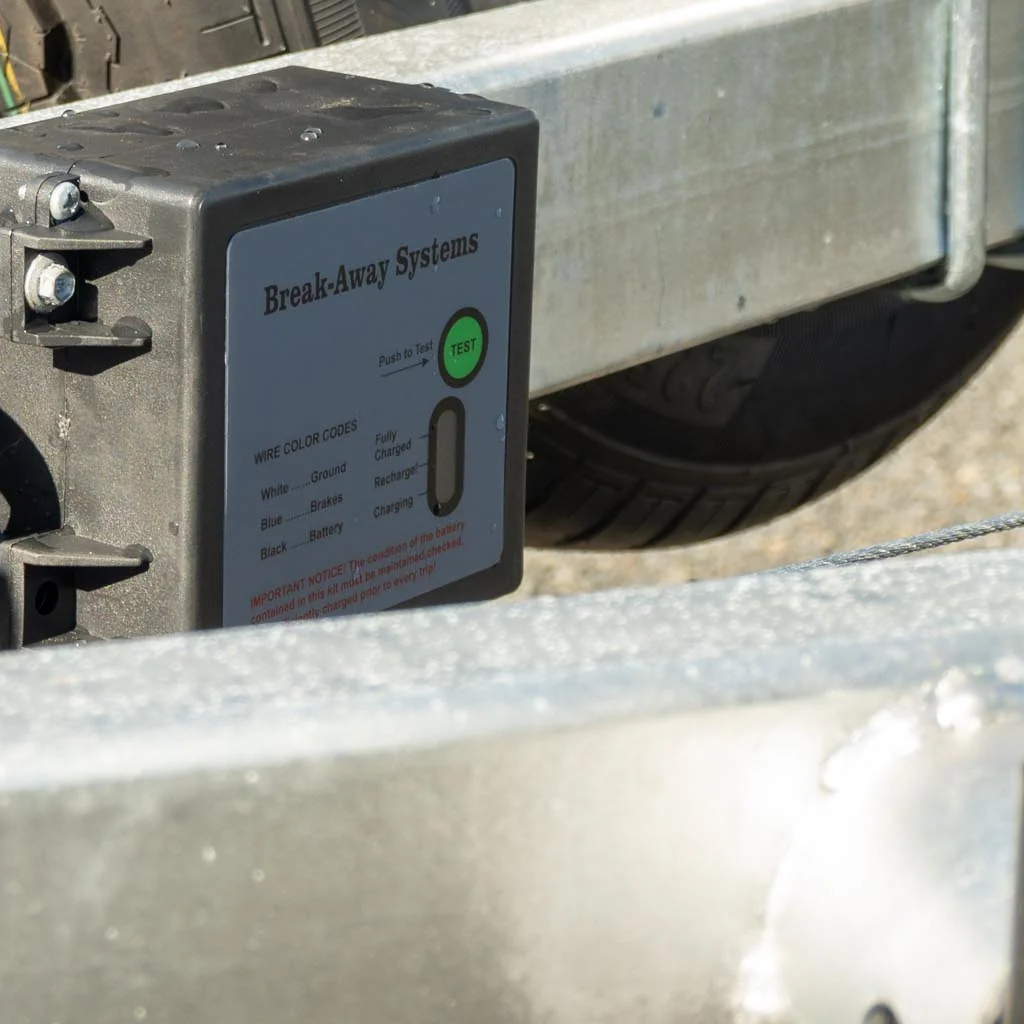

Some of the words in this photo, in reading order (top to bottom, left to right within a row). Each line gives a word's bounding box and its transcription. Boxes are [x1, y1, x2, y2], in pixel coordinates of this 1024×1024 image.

[264, 258, 390, 315] Break-Away
[395, 232, 479, 280] Systems
[378, 351, 402, 368] Push
[404, 346, 413, 359] to
[414, 339, 434, 355] Test
[450, 338, 477, 357] TEST
[253, 445, 281, 465] WIRE
[283, 432, 320, 455] COLOR
[322, 419, 358, 442] CODES
[375, 430, 398, 445] Fully
[374, 440, 412, 461] Charged
[373, 496, 413, 518] Charging
[250, 578, 305, 608] IMPORTANT
[367, 542, 407, 564] condition
[409, 537, 419, 549] of
[308, 589, 325, 602] this
[327, 583, 339, 596] kit
[360, 584, 380, 601] prior
[382, 580, 392, 591] to
[393, 571, 417, 587] every
